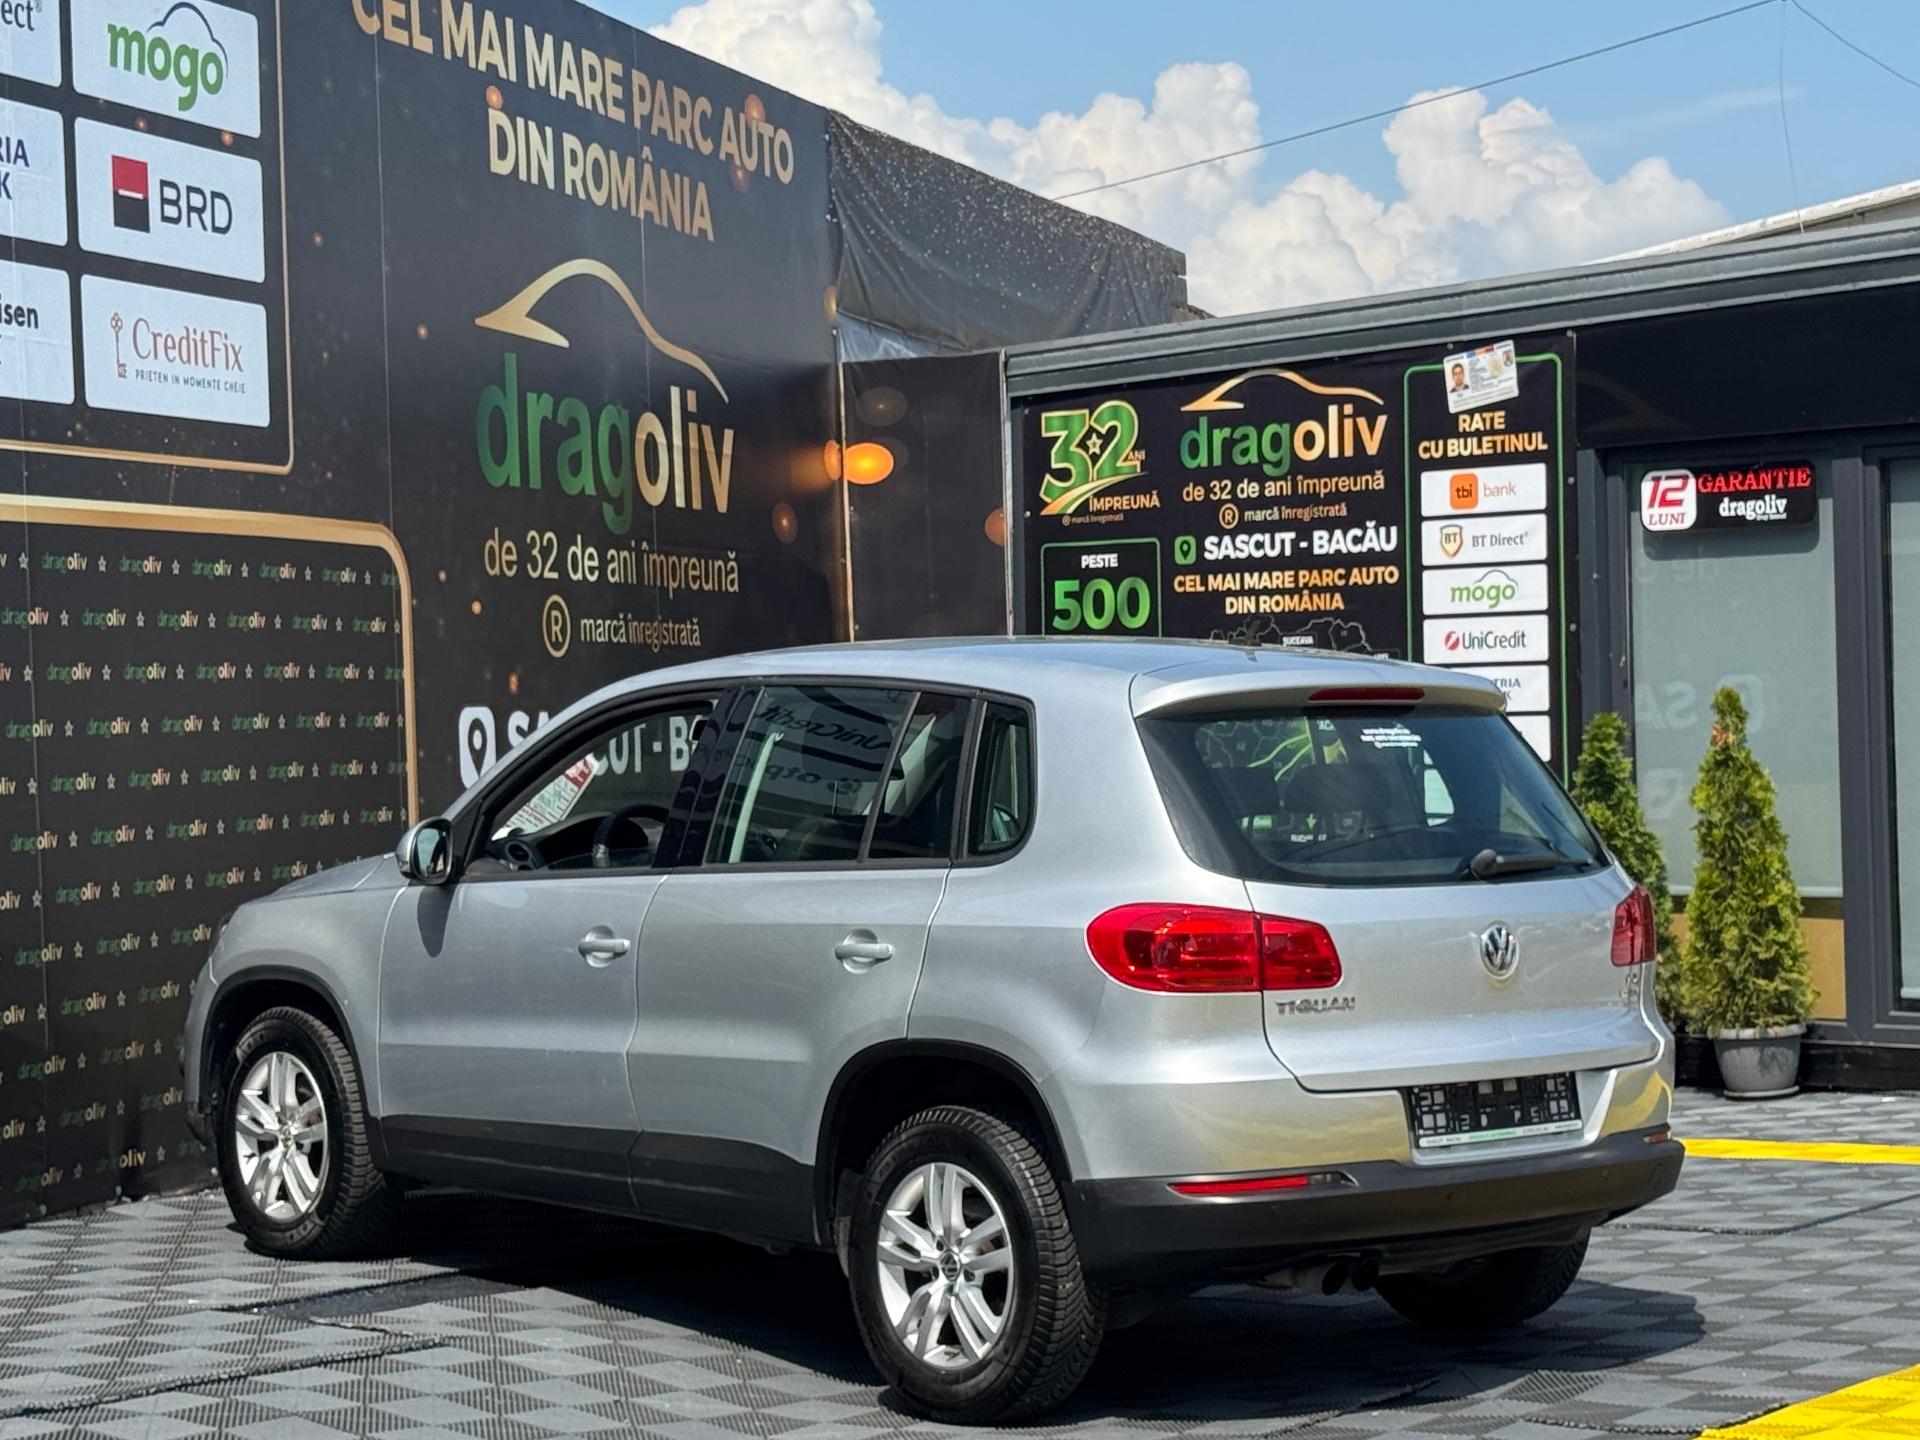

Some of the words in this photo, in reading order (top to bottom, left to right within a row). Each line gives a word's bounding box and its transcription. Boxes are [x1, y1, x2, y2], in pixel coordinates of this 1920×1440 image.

[107, 23, 224, 112] mogo
[352, 0, 433, 54] CEL
[441, 0, 517, 83] MAI
[524, 24, 626, 124] MARE
[631, 67, 713, 156] PARC
[719, 107, 794, 184] AUTO
[487, 107, 555, 190] DIN
[563, 132, 714, 242] ROMÂNIA
[159, 179, 233, 235] BRD
[133, 318, 244, 373] CreditFix
[135, 369, 169, 383] PRIETEN
[172, 375, 181, 385] IN
[183, 377, 222, 391] MOMENTE
[1458, 410, 1506, 432] RATE
[475, 352, 735, 535] dragoliv
[1039, 399, 1139, 506] 32
[1180, 403, 1388, 478] dragoliv
[1418, 439, 1444, 460] CU
[1447, 430, 1548, 457] BULETINUL
[1182, 481, 1204, 502] de
[1209, 480, 1231, 500] 32
[1237, 478, 1259, 498] de
[1264, 475, 1291, 496] ani
[1296, 469, 1385, 498] împreună
[1455, 484, 1473, 499] tbi
[1483, 481, 1517, 497] bank
[1648, 475, 1690, 508] 12
[1698, 467, 1812, 493] GARANTIE
[1089, 490, 1161, 512] ÎMPREUNĂ
[1244, 506, 1280, 521] marcă
[1281, 502, 1347, 523] înregistrată
[1719, 494, 1788, 520] dragoliv
[1648, 513, 1686, 526] LUNI
[1203, 532, 1296, 561] SASCUT
[1312, 520, 1399, 555] BACĂU
[1444, 532, 1458, 544] BT
[1472, 534, 1487, 548] BT
[41, 552, 87, 574] dragoliv
[118, 555, 162, 576] dragoliv
[192, 559, 232, 579] dragoliv
[484, 527, 517, 578] de
[526, 530, 559, 580] 32
[568, 534, 599, 583] de
[606, 540, 636, 586] ani
[643, 544, 740, 600] împreună
[1081, 552, 1118, 569] PESTE
[1174, 574, 1205, 592] CEL
[1208, 573, 1240, 591] MAI
[1244, 570, 1295, 589] MARE
[1299, 568, 1345, 588] PARC
[1348, 565, 1400, 585] AUTO
[1052, 577, 1151, 632] 500
[1225, 597, 1257, 615] DIN
[1260, 592, 1344, 613] ROMÂNIA
[1450, 583, 1516, 610] mogo
[2, 607, 49, 629] dragoliv
[81, 608, 126, 630] dragoliv
[158, 609, 198, 631] dragoliv
[580, 613, 626, 644] marcă
[628, 613, 701, 653] înregistrată
[1462, 629, 1526, 649] UniCredit
[47, 662, 92, 684] dragoliv
[122, 662, 166, 683] dragoliv
[195, 662, 236, 683] dragoliv
[6, 719, 54, 741] dragoliv
[87, 716, 131, 738] dragoliv
[160, 715, 203, 736] dragoliv
[51, 772, 96, 795] dragoliv
[128, 768, 173, 790] dragoliv
[198, 764, 240, 786] dragoliv
[10, 831, 58, 854] dragoliv
[90, 824, 135, 847] dragoliv
[166, 819, 207, 841] dragoliv
[55, 882, 101, 906] dragoliv
[132, 874, 175, 897] dragoliv
[15, 943, 63, 968] dragoliv
[96, 933, 140, 956] dragoliv
[171, 924, 212, 946] dragoliv
[1275, 996, 1356, 1015] TIGUAN
